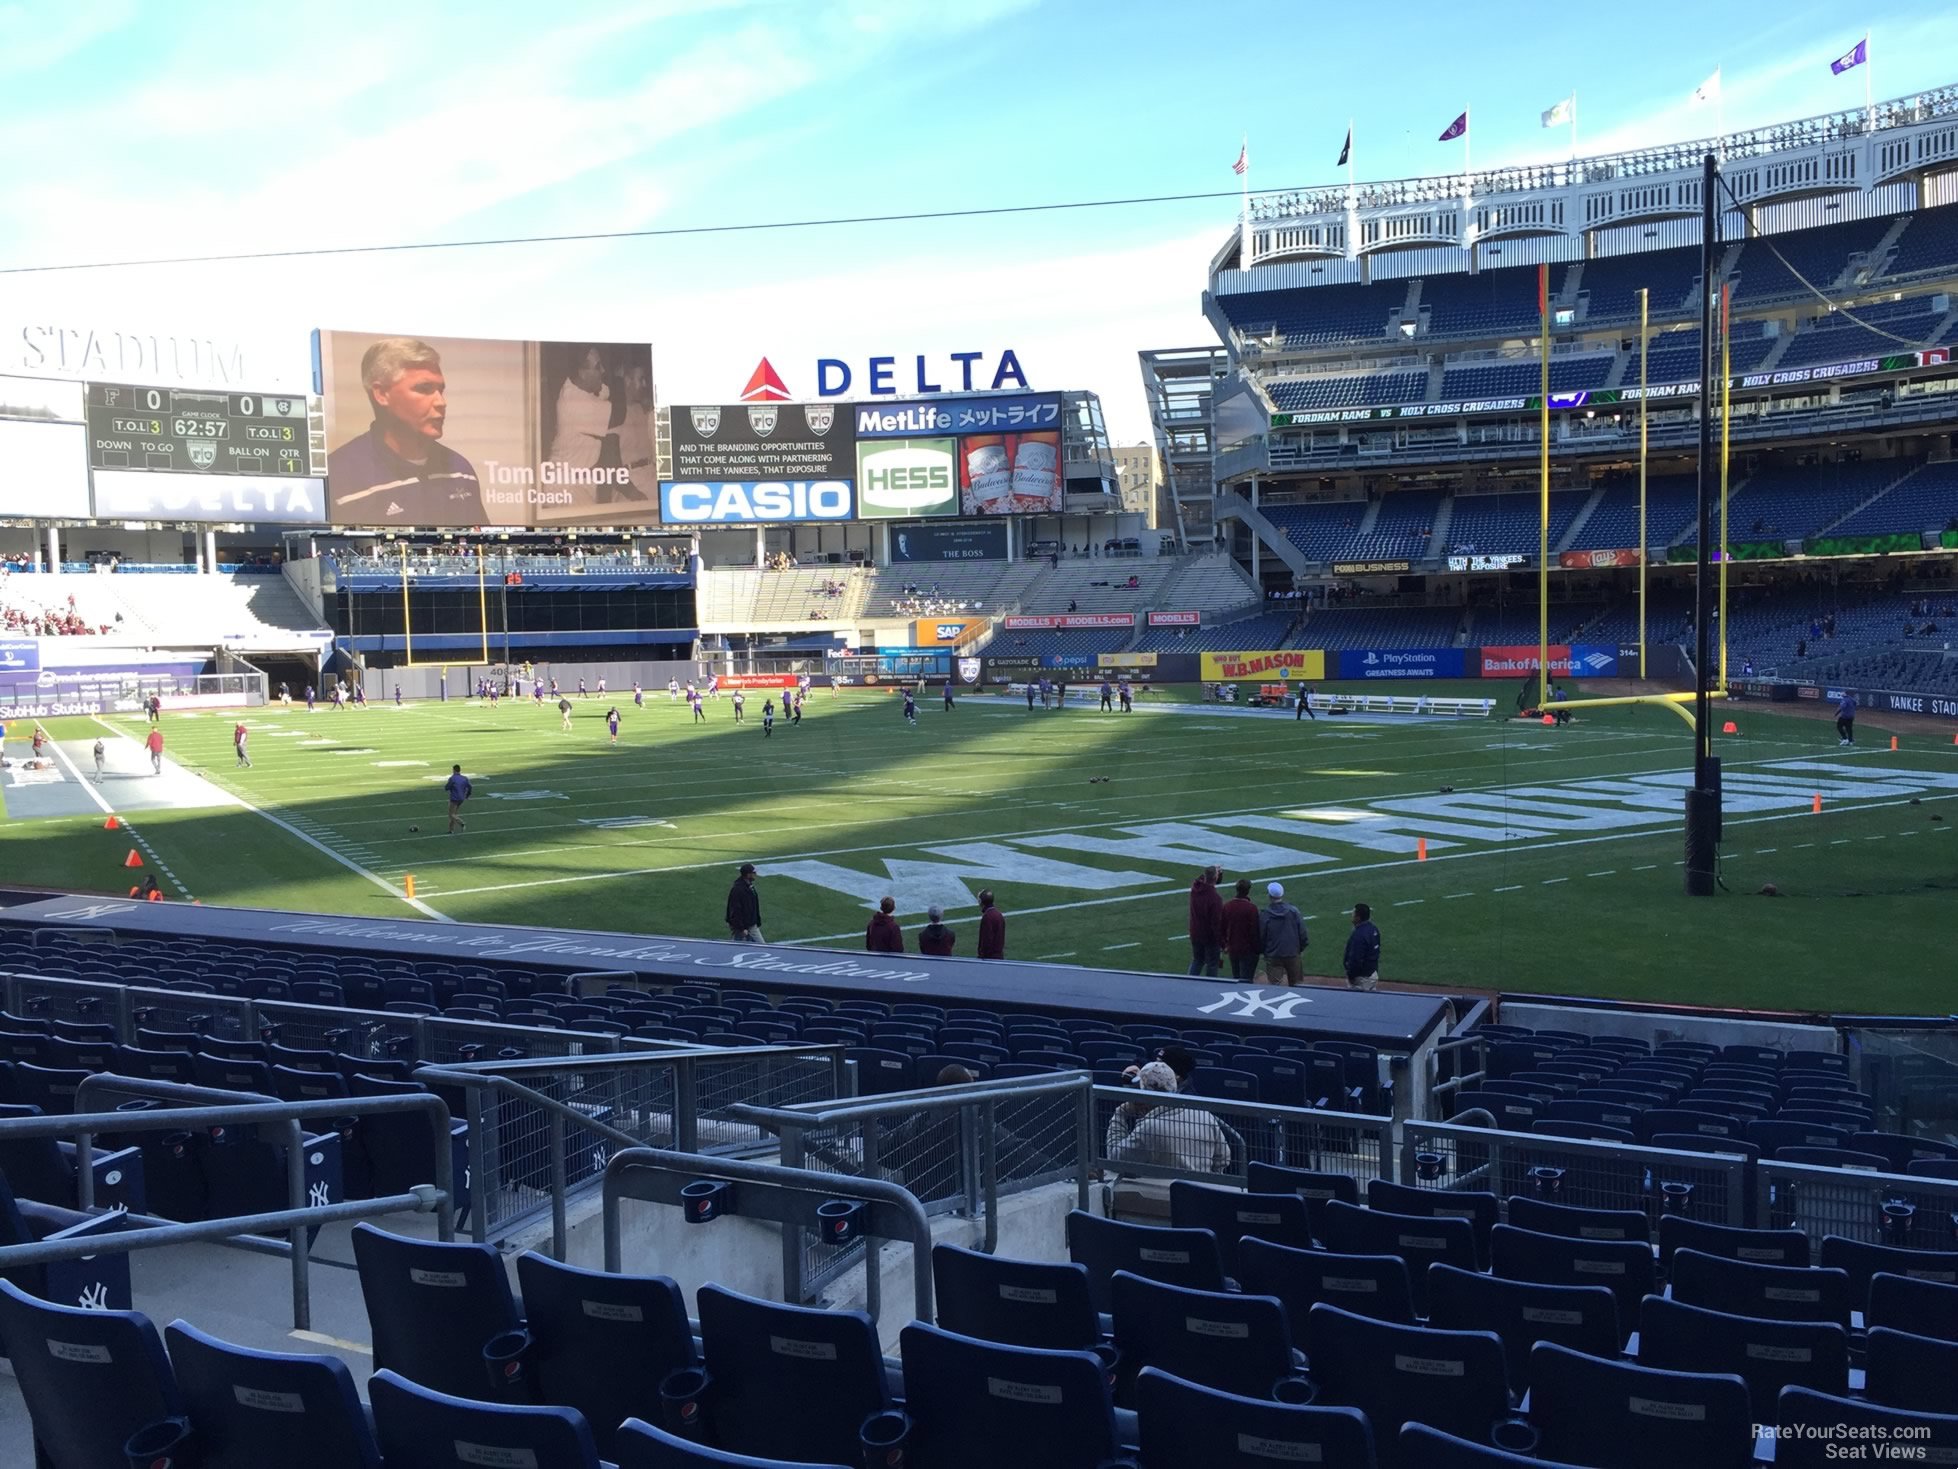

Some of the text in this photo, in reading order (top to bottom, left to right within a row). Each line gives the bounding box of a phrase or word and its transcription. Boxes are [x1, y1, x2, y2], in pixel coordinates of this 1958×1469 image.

[817, 349, 1030, 397] DELTA
[1743, 359, 1878, 387] HOLY CROSS CRUSADERS
[1678, 381, 1702, 395] RAM
[147, 390, 161, 410] 0
[240, 396, 254, 415] 0
[200, 411, 221, 419] CLOCK
[959, 404, 1059, 427] メットライフ
[1291, 398, 1526, 424] FORDHAM RAMS VS HOLY CROSS CRUSADERS
[858, 406, 952, 432] MetLife
[150, 420, 160, 433] 3
[175, 419, 227, 437] 62:57
[282, 428, 292, 440] 3
[97, 440, 174, 452] DOWN TO GO
[717, 443, 759, 452] BRANDING
[761, 442, 825, 451] OPPORTUNITIES
[229, 447, 300, 458] BALL ON QTR
[680, 454, 833, 464] THAT COME ALONG WITH PARTNERING
[484, 461, 630, 485] Tom Gilmore
[680, 465, 828, 475] WITH THE YANKEES, THAT EXPOSURE
[868, 467, 949, 490] HESS
[486, 489, 523, 504] Head
[527, 489, 573, 504] Coach
[669, 481, 850, 521] CASIO
[942, 549, 984, 558] THE BOSS
[1356, 562, 1409, 572] BUSINESS
[1471, 562, 1508, 571] EXPOSURE
[1010, 617, 1050, 626] MODELL'S
[1066, 616, 1129, 626] MODELLS.com
[1153, 614, 1195, 623] MODELL'S
[937, 626, 961, 640] SAP
[827, 649, 854, 658] FedEx
[1383, 653, 1436, 663] PlayStation
[1064, 656, 1087, 664] pepsi
[1484, 659, 1516, 671] Bank
[1517, 659, 1531, 671] of
[1365, 668, 1434, 677] GREATNESS AWAITS
[0, 704, 48, 718] StubHub
[51, 701, 100, 715] StubHub
[1890, 695, 1958, 716] YANKEE STAD
[270, 920, 458, 944] Welcome
[478, 936, 691, 964] Yankee
[694, 951, 930, 982] Stadium
